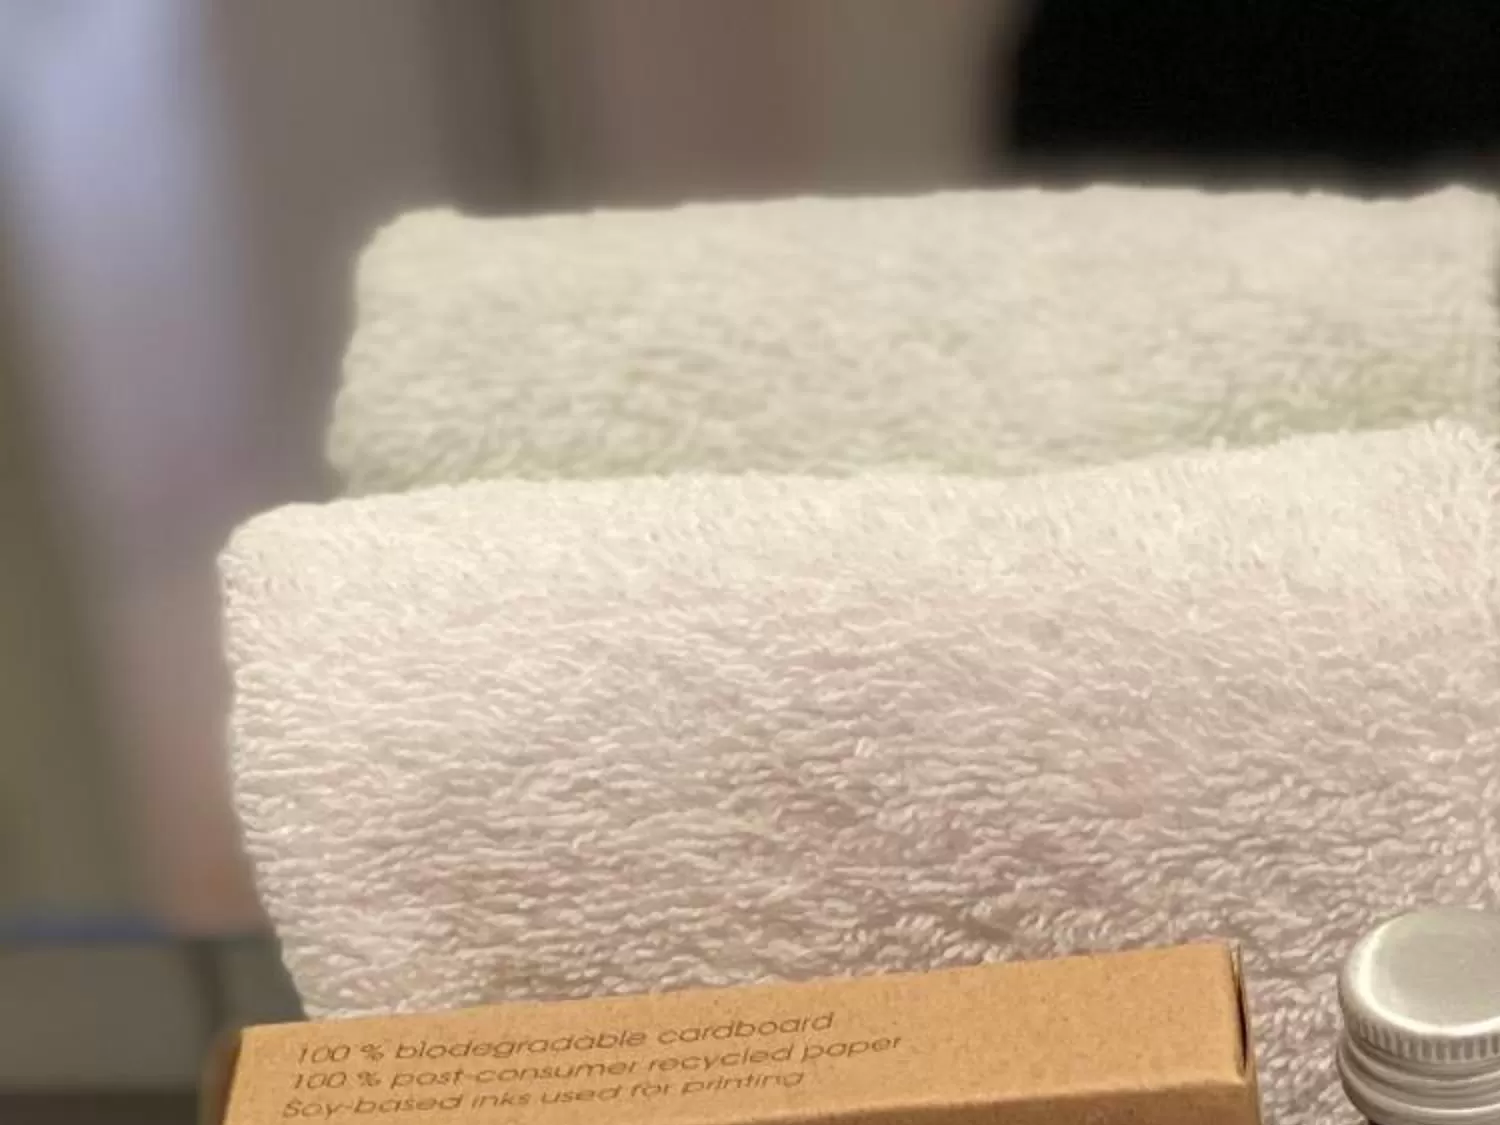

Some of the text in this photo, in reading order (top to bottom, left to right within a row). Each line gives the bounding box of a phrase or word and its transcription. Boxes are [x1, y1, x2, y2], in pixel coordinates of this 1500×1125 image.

[293, 1036, 901, 1090] 100 % post-consumer recycled paper
[299, 1012, 834, 1064] 100 % biodegradable cardboard
[283, 1072, 806, 1119] Soy-based inks used for printing
